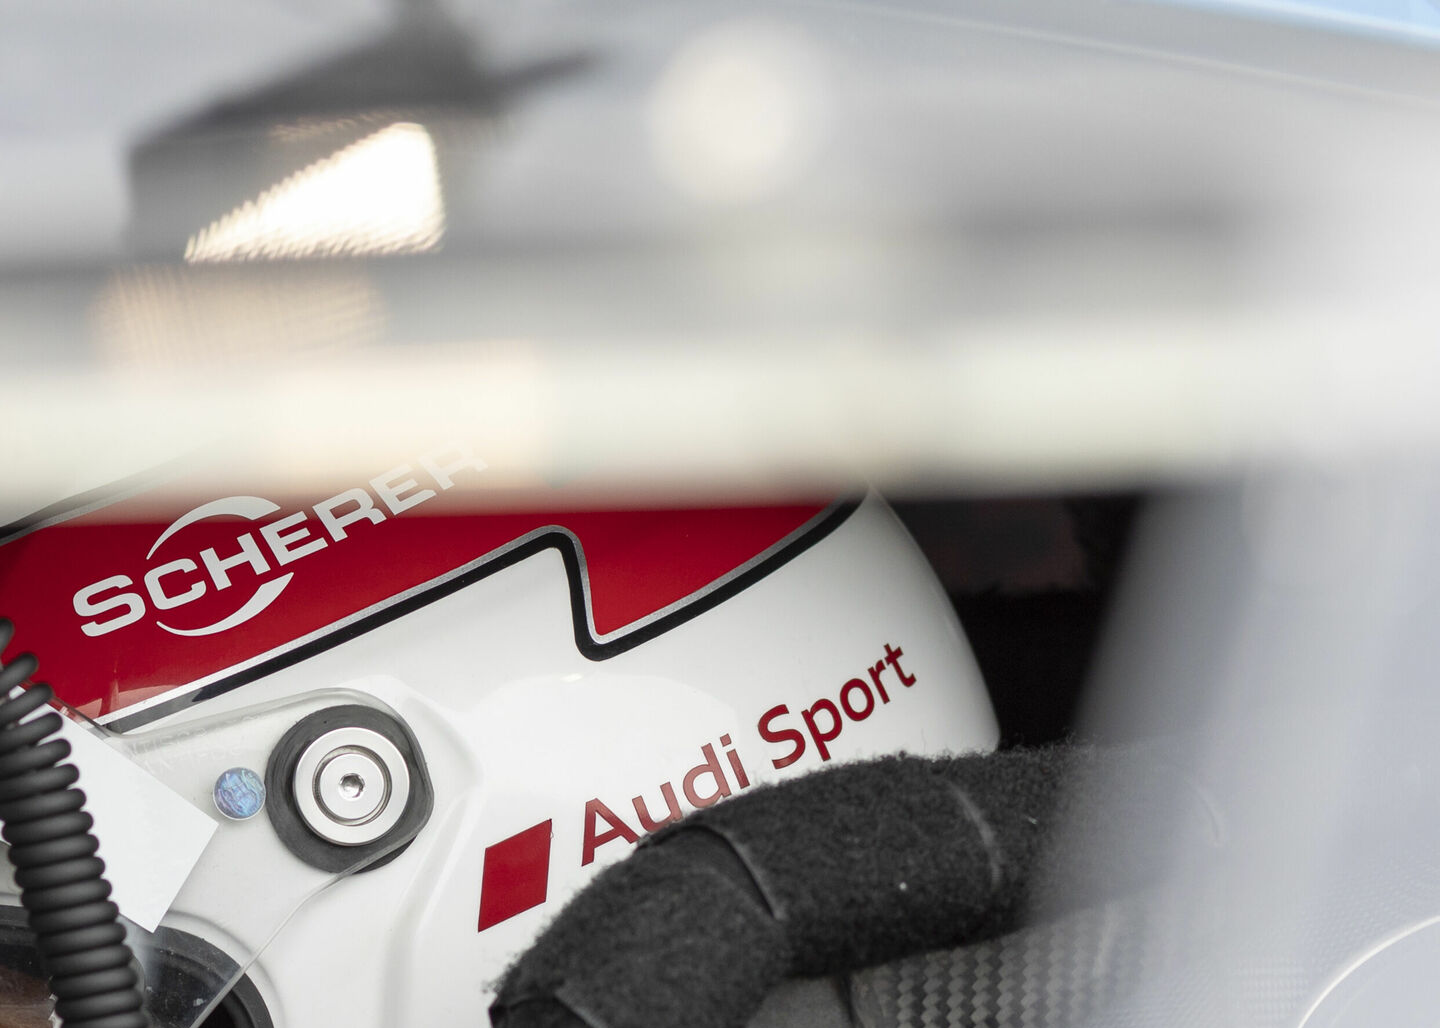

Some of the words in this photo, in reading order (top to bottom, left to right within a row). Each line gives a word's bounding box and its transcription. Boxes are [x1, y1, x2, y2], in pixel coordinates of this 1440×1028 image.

[72, 440, 489, 638] SCHERER
[581, 733, 751, 867] Audi
[758, 643, 917, 771] Sport
